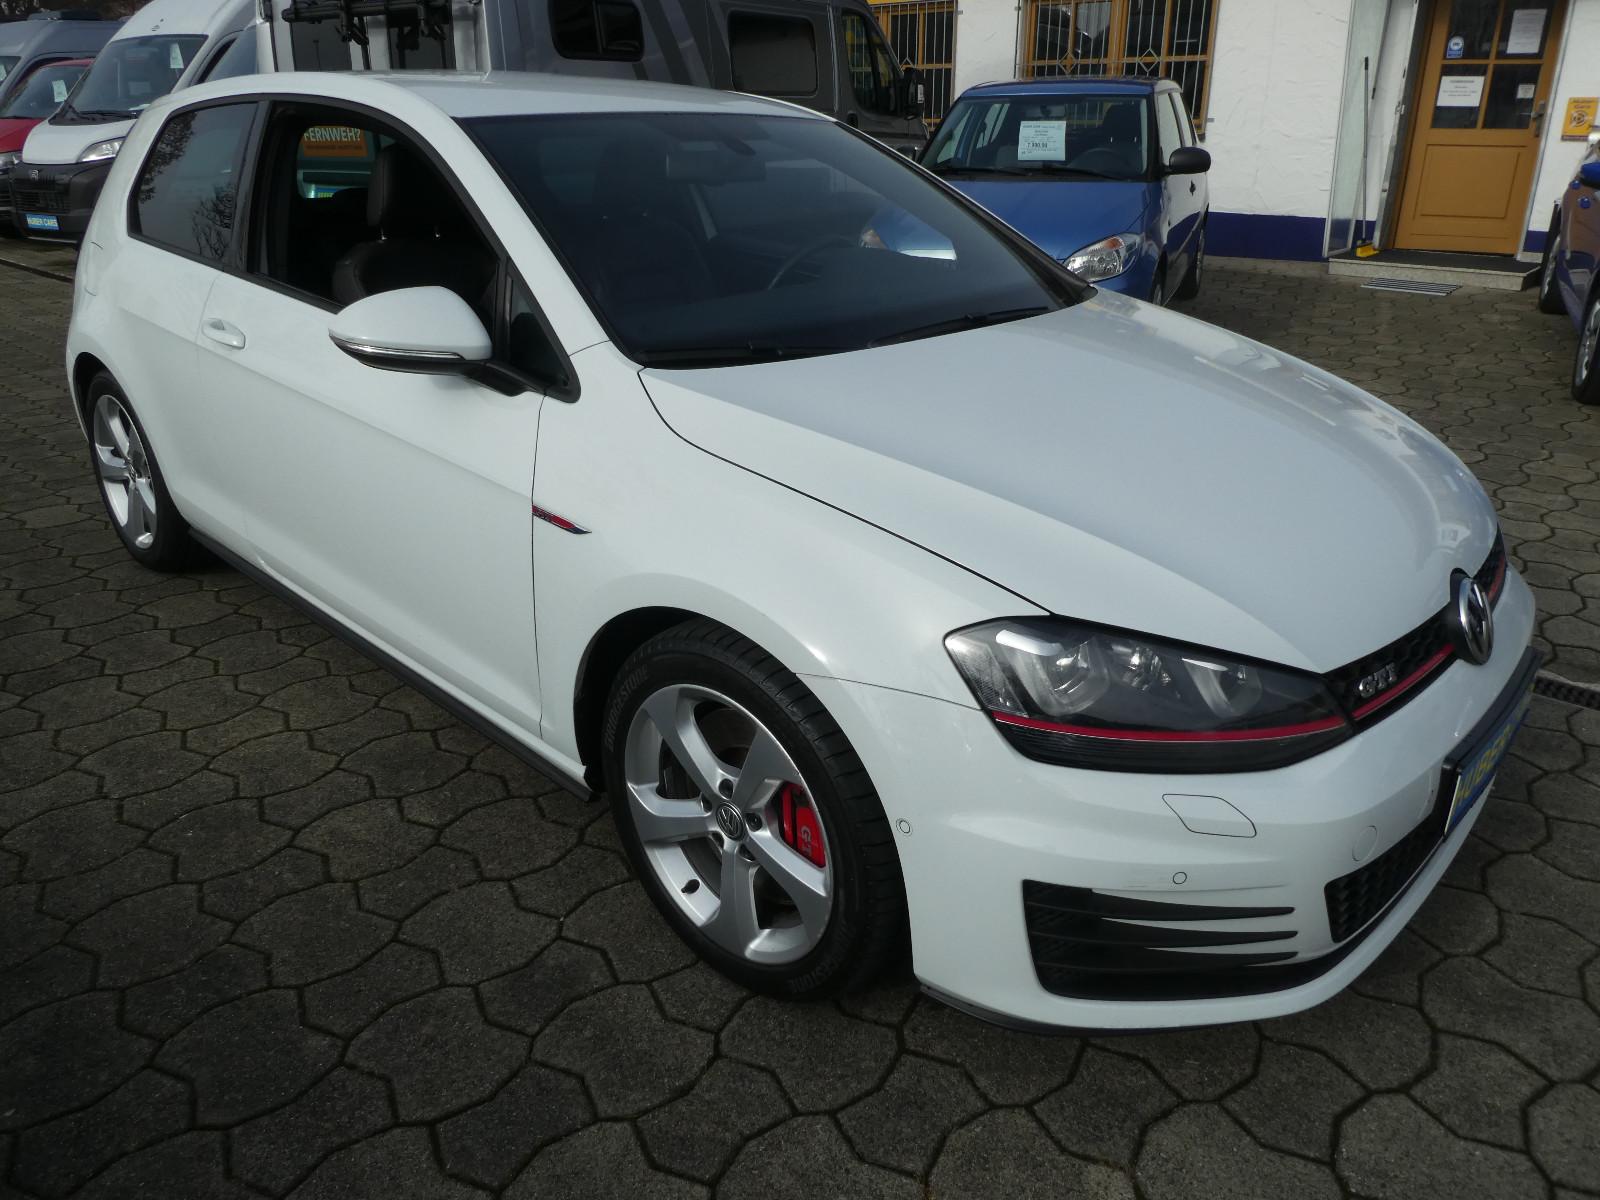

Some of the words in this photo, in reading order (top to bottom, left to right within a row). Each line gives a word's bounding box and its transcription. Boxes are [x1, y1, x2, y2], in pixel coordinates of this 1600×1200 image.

[303, 127, 361, 142] FERNWEH?
[1358, 662, 1395, 697] GTI
[603, 663, 650, 753] BRIDGESTONE
[800, 825, 812, 857] GT
